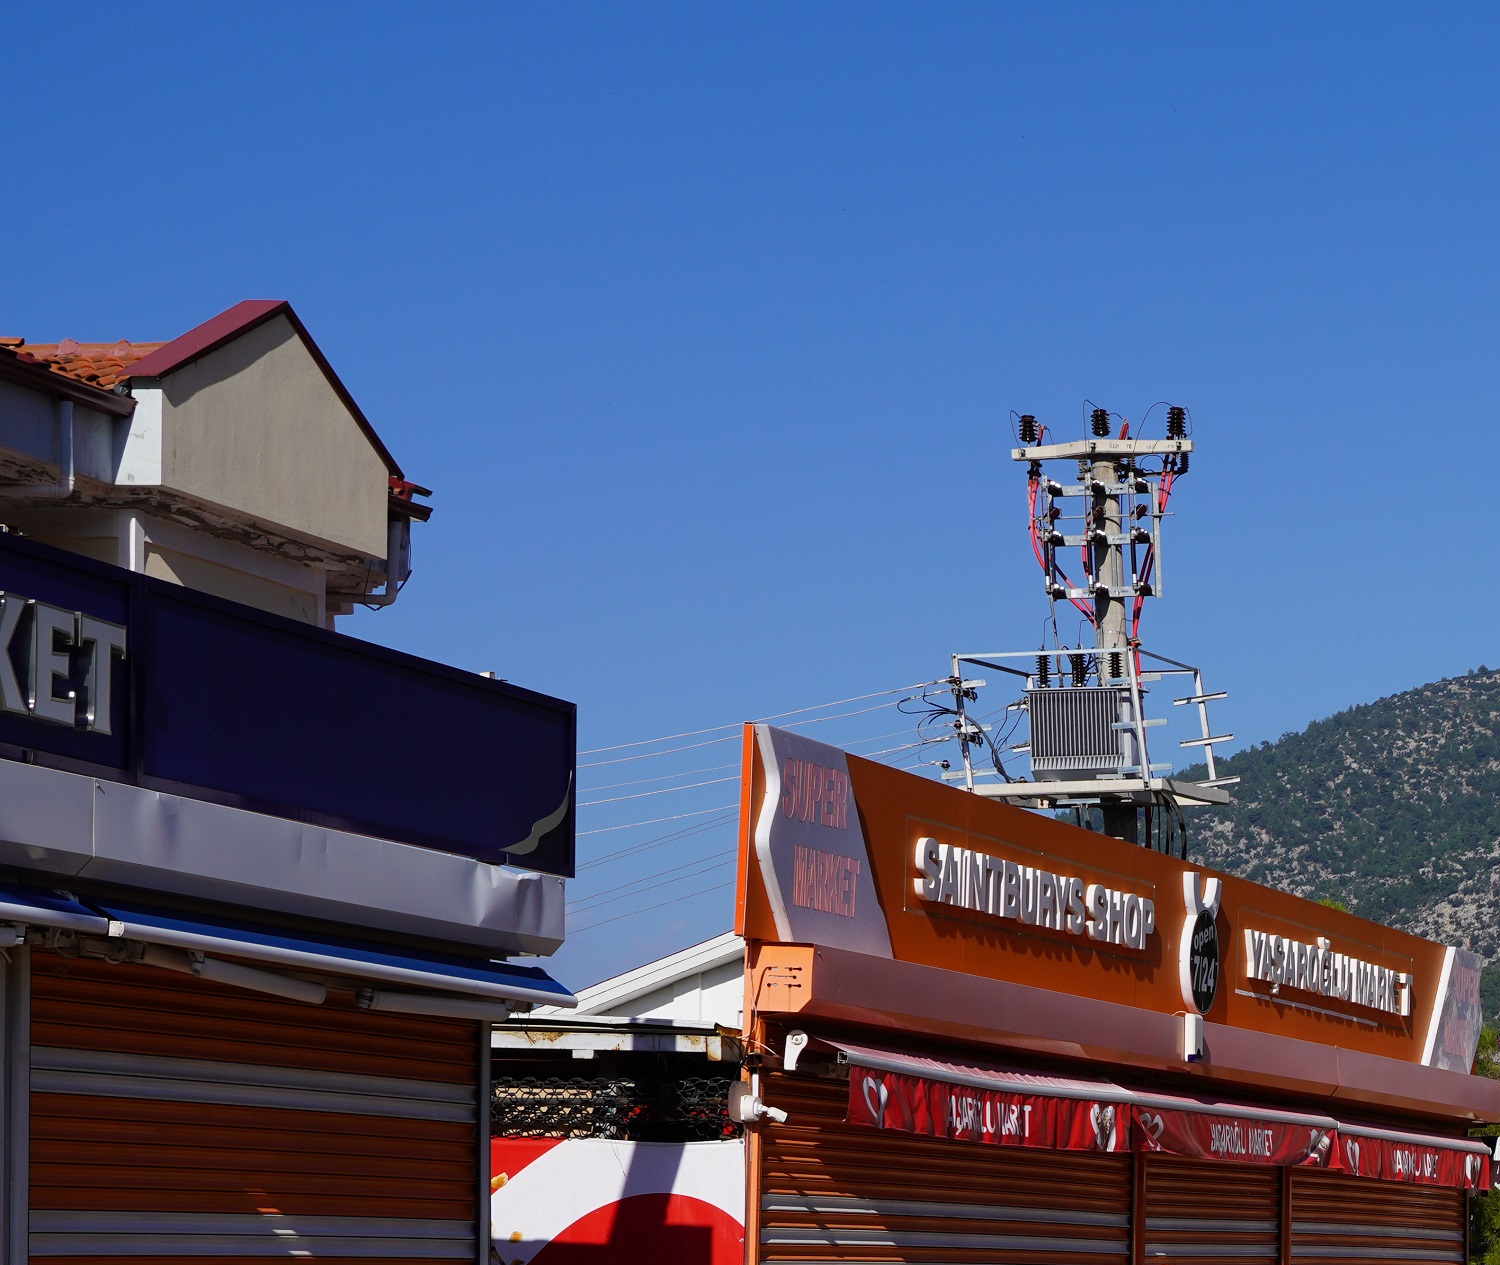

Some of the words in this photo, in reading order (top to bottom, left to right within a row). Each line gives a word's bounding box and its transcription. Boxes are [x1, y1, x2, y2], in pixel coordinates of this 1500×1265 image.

[782, 758, 847, 830] SUPER
[793, 845, 860, 918] MARKET
[914, 837, 1085, 935] SAINTBURYS
[1085, 884, 1155, 950] SHOP
[1193, 923, 1215, 952] open
[1244, 929, 1350, 1000] YAŞAROĞLU
[1350, 958, 1413, 1016] MARKT
[1193, 955, 1215, 993] 7/24
[996, 1101, 1032, 1137] MART
